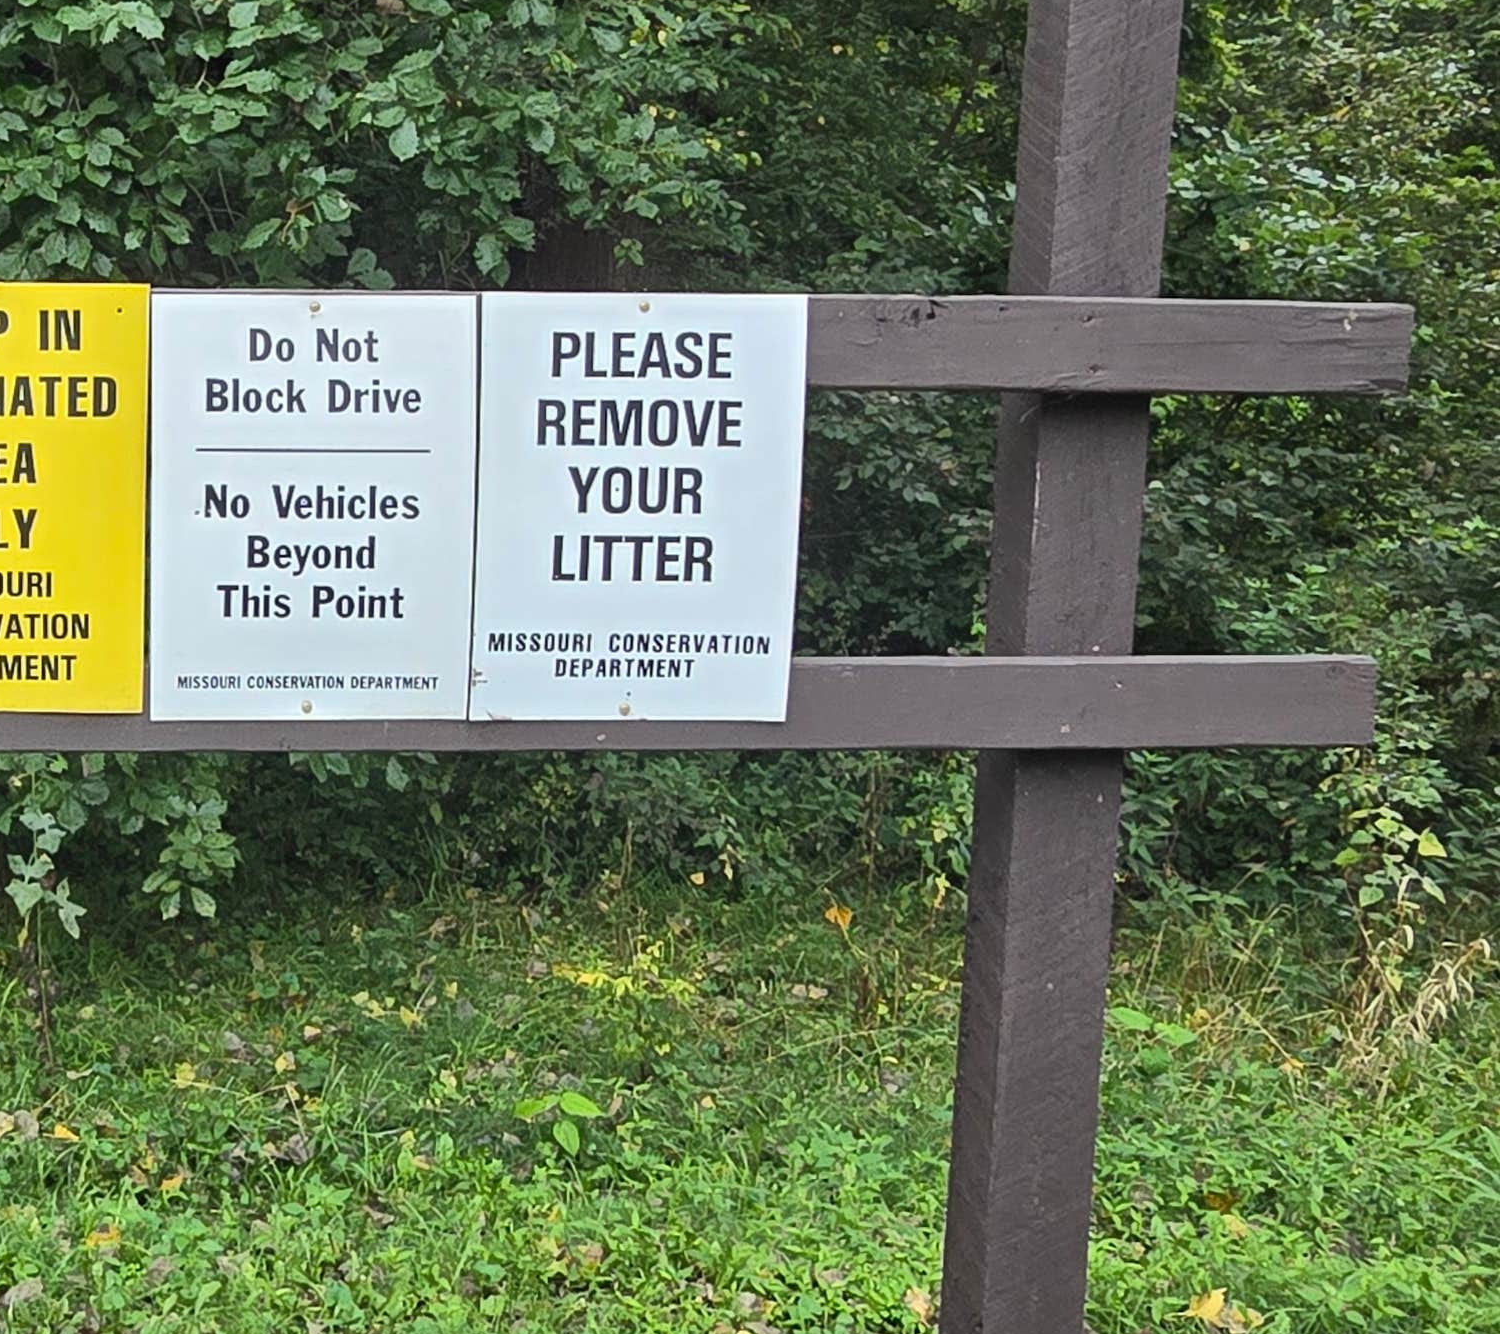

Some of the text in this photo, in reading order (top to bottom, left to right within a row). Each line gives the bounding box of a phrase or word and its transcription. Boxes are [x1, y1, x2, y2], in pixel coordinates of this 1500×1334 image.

[39, 309, 81, 351] IN
[249, 328, 379, 363] Do Not
[550, 331, 733, 378] PLEASE
[204, 379, 422, 414] Block Drive
[536, 400, 742, 448] REMOVE
[203, 485, 420, 520] No Vehicles
[568, 466, 701, 515] YOUR
[246, 536, 375, 576] Beyond
[552, 535, 713, 582] LITTER
[217, 585, 403, 619] This Point
[487, 633, 770, 654] MISSOURI CONSERVATION
[176, 676, 438, 690] MISSOURI CONSERVATION DEPARTMENT
[554, 659, 695, 679] DEPARTMENT
